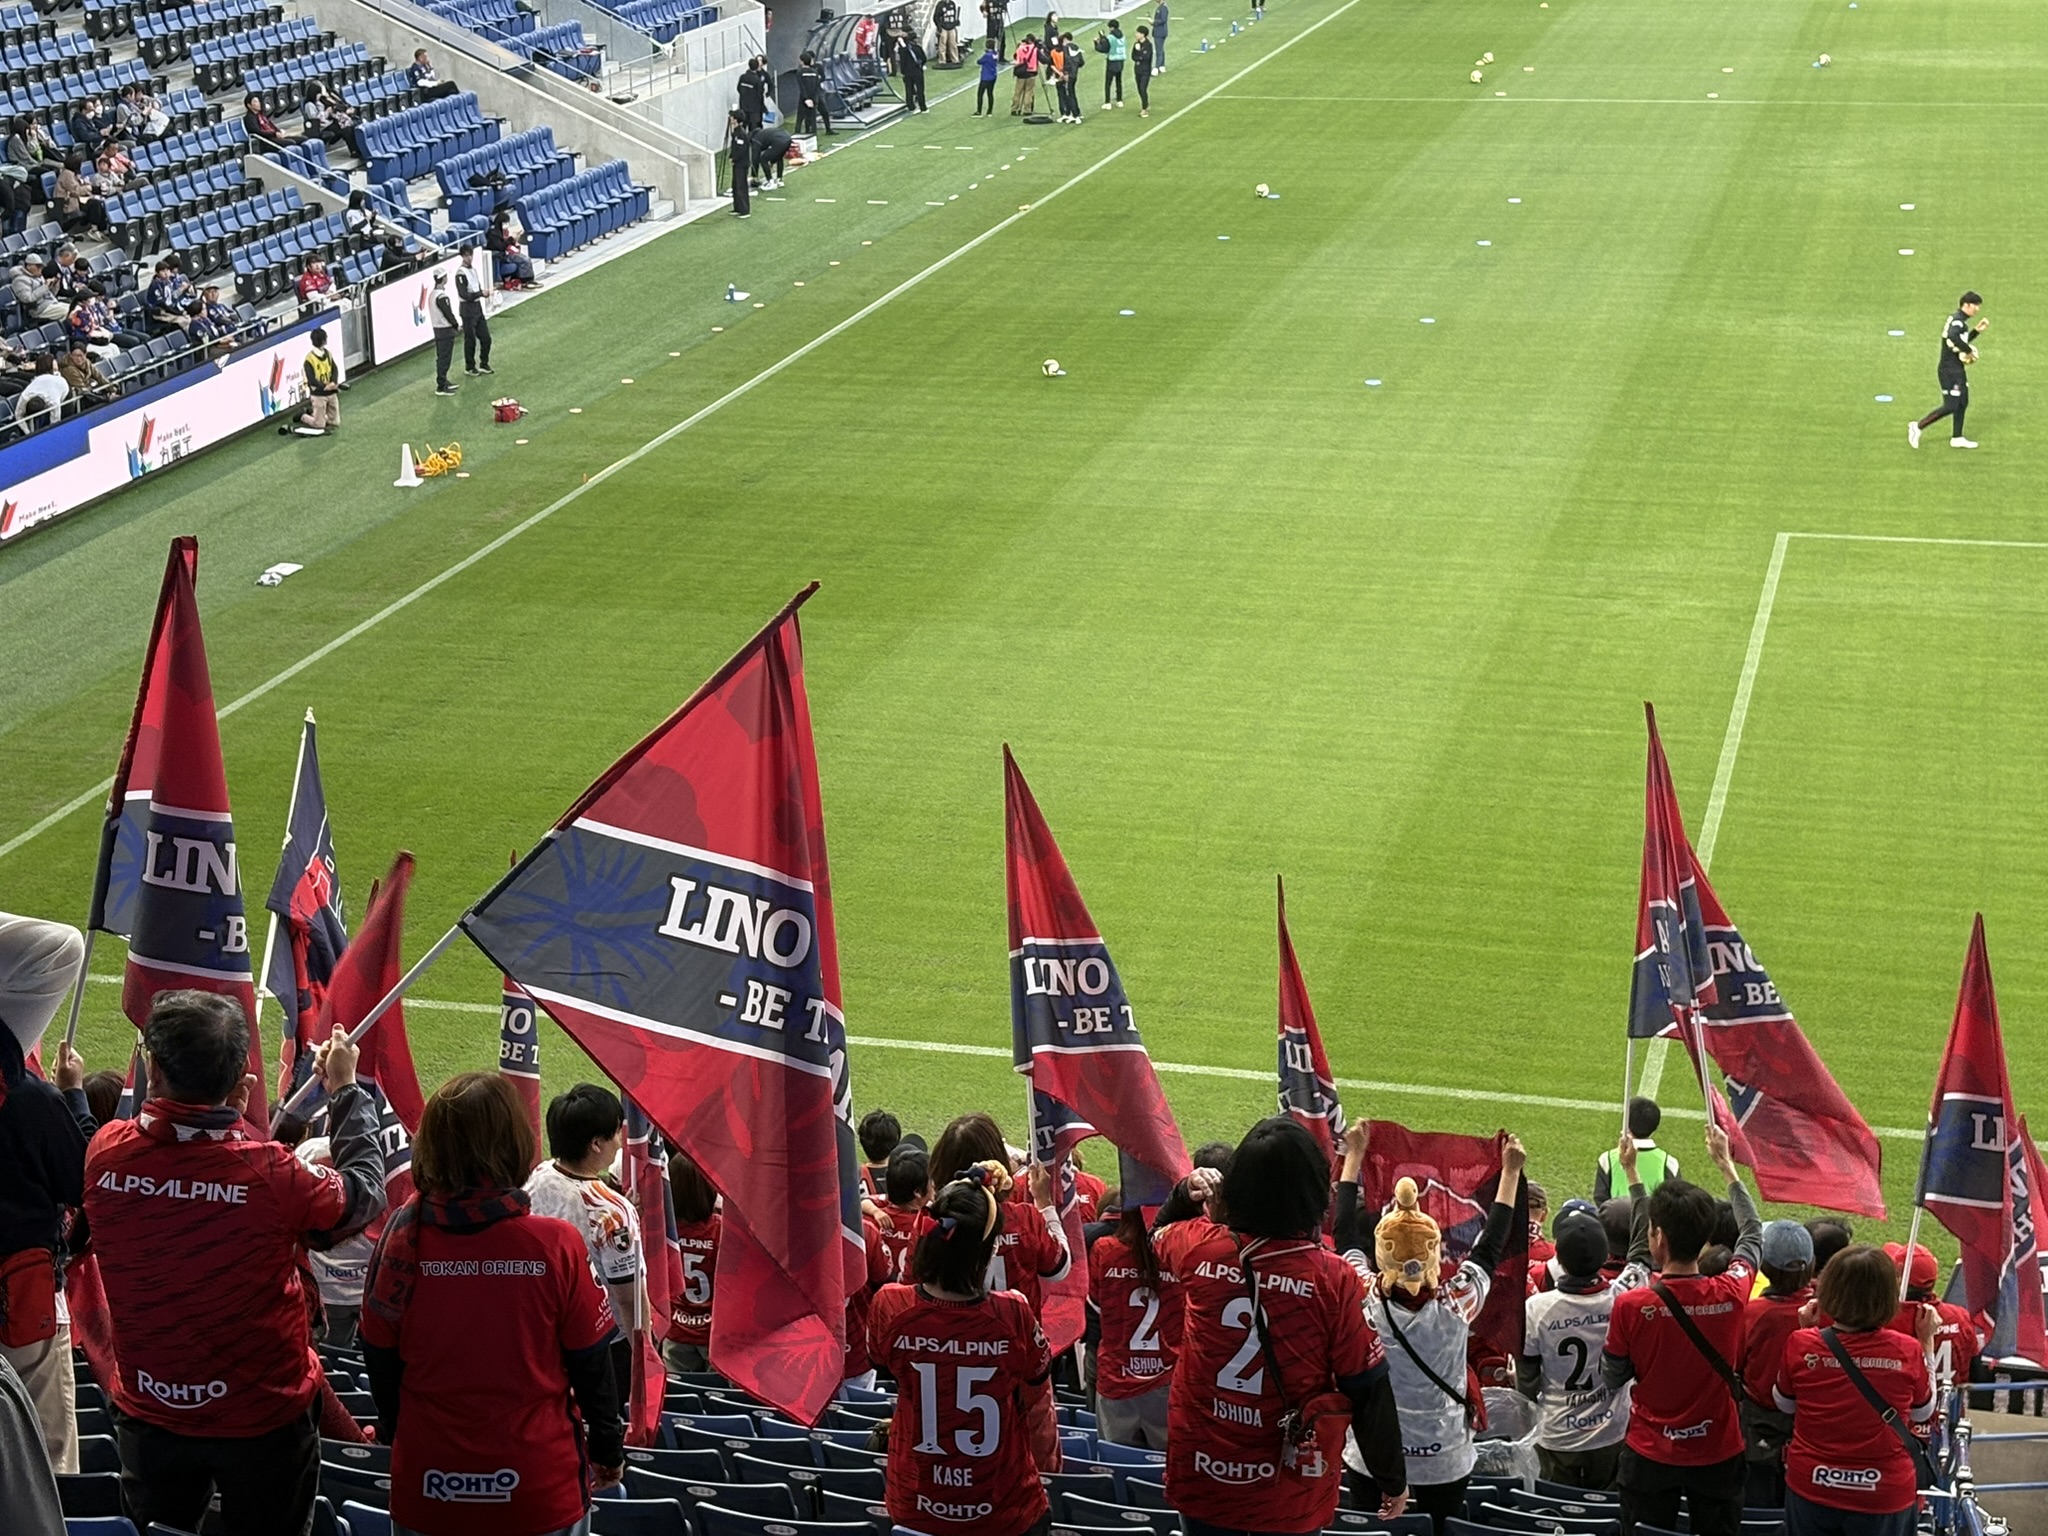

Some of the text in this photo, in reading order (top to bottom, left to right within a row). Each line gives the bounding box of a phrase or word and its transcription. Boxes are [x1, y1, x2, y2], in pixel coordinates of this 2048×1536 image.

[142, 830, 243, 896] LIN
[199, 915, 250, 953] -B
[657, 876, 812, 968] LINO
[804, 998, 830, 1044] T
[96, 1170, 250, 1204] ALPSALPINE
[420, 1260, 479, 1277] TOKAN
[482, 1260, 547, 1276] ORIENS
[1194, 1260, 1315, 1299] ALPSLPINE
[1129, 1286, 1160, 1351] 2
[893, 1335, 1010, 1356] ALPSALPINE
[1216, 1297, 1268, 1395] 2
[137, 1369, 228, 1409] ROHTO
[909, 1361, 1000, 1457] 15
[1213, 1397, 1263, 1428] ISHIDA
[1566, 1409, 1613, 1431] ROHTO
[933, 1464, 973, 1487] KASE
[1195, 1450, 1275, 1484] ROHTO
[1813, 1465, 1881, 1490] ROHTO
[424, 1468, 519, 1502] ROHTO
[917, 1495, 993, 1522] ROHTO
